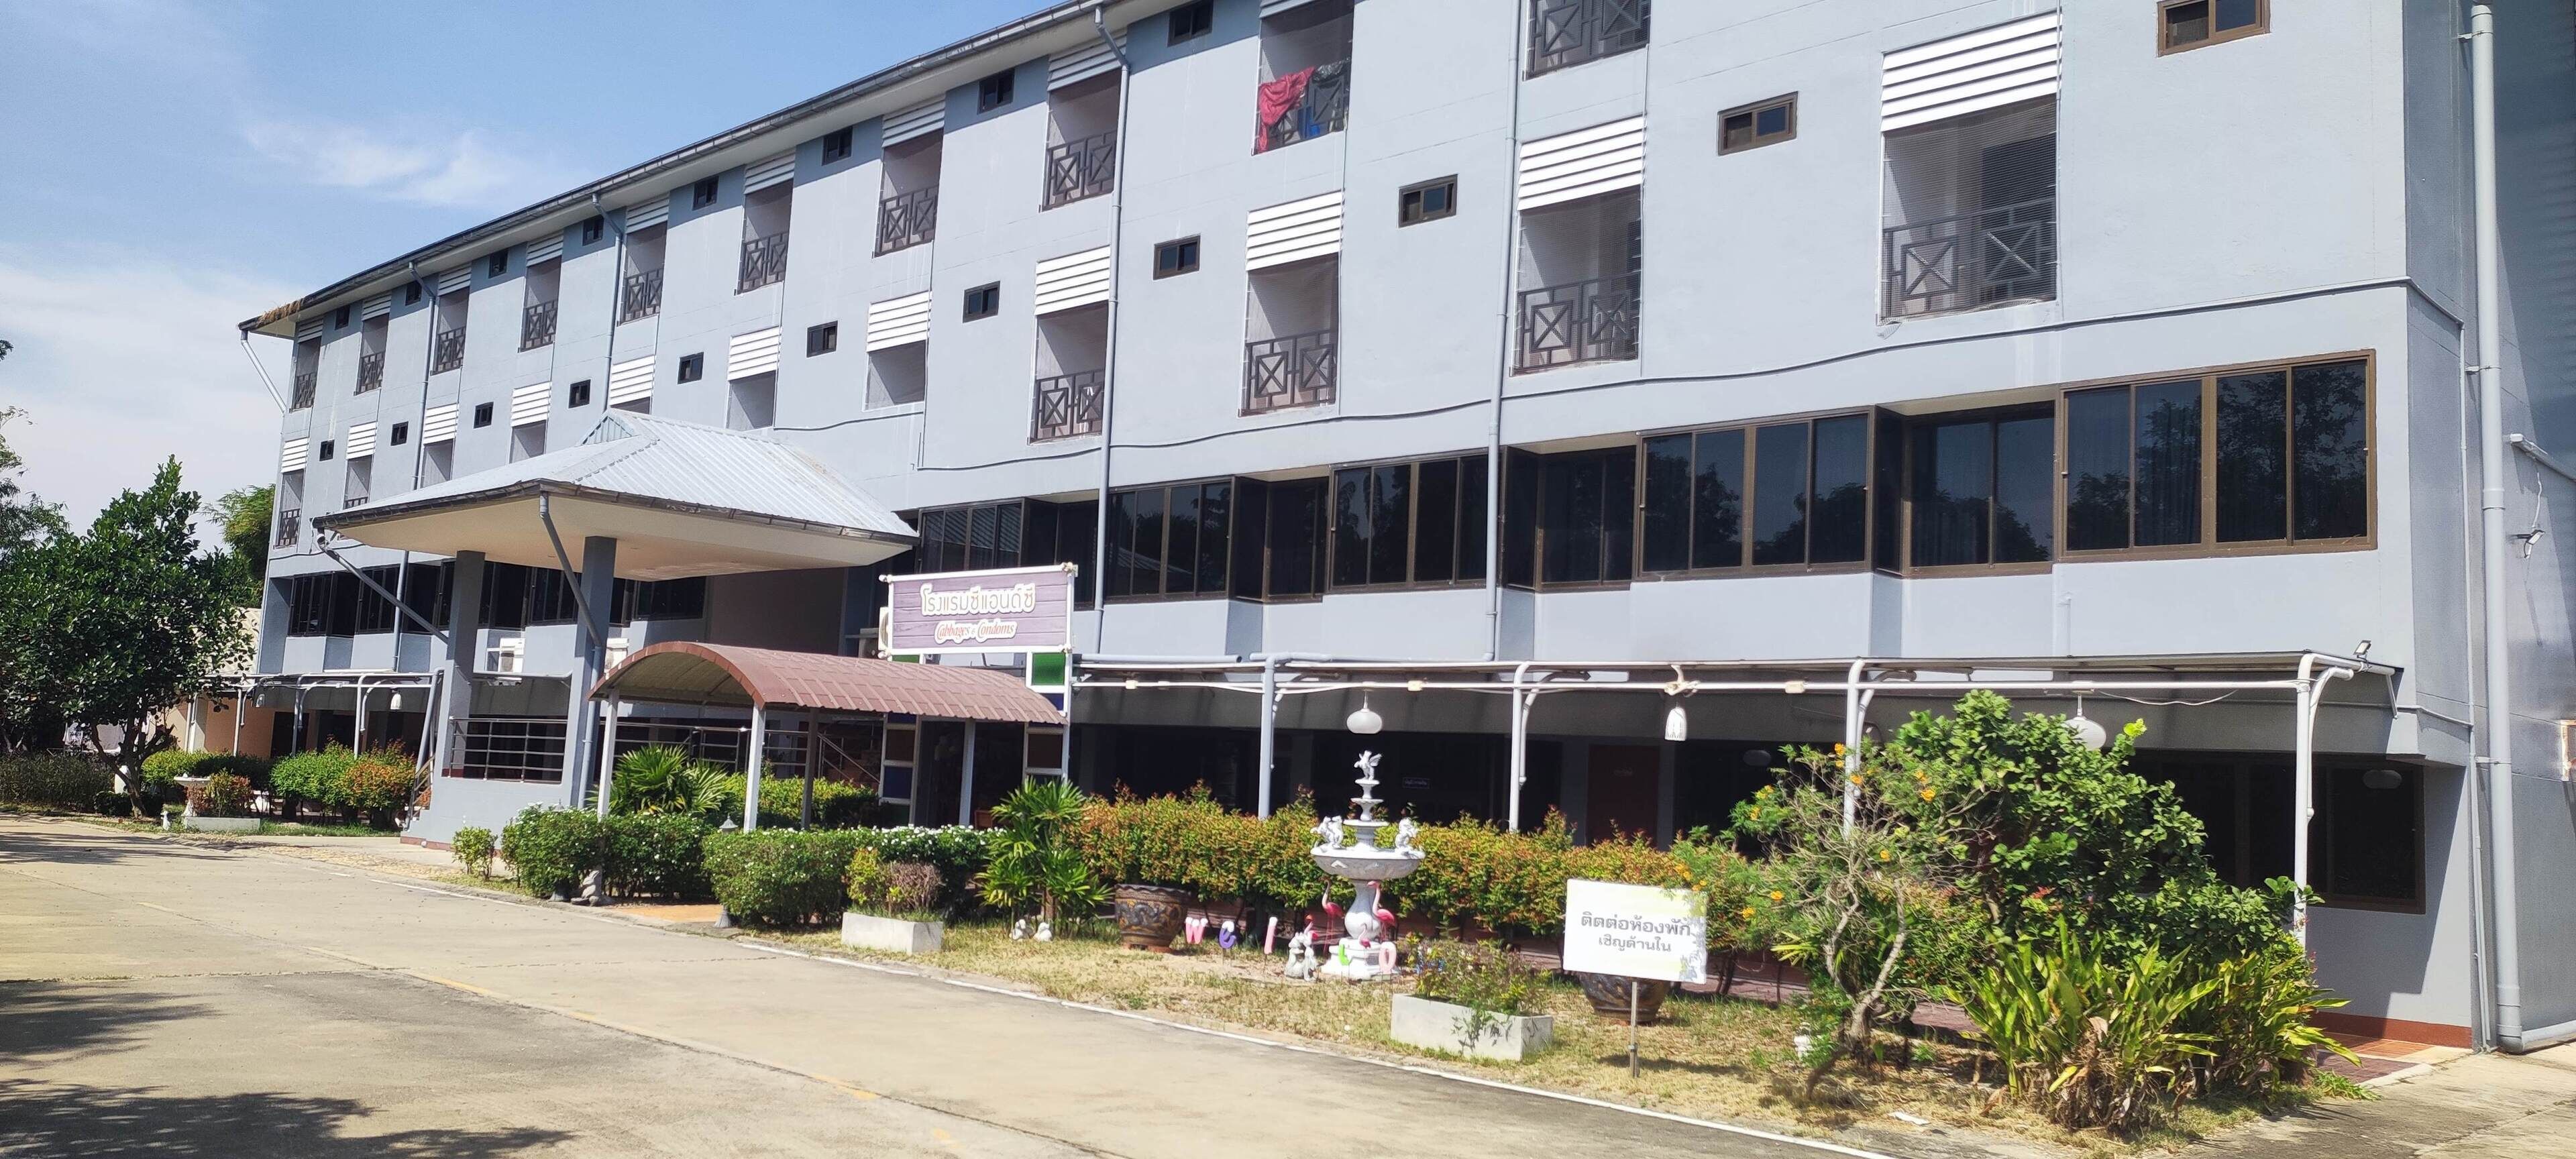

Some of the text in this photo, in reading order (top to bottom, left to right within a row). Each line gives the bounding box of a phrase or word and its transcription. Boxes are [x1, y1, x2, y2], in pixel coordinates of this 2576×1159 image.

[936, 624, 970, 640] Cabbages
[977, 621, 1015, 639] Condoms
[1581, 911, 1690, 936] ติดต่อห้องพัก
[1599, 934, 1671, 952] เชิญด้านใน
